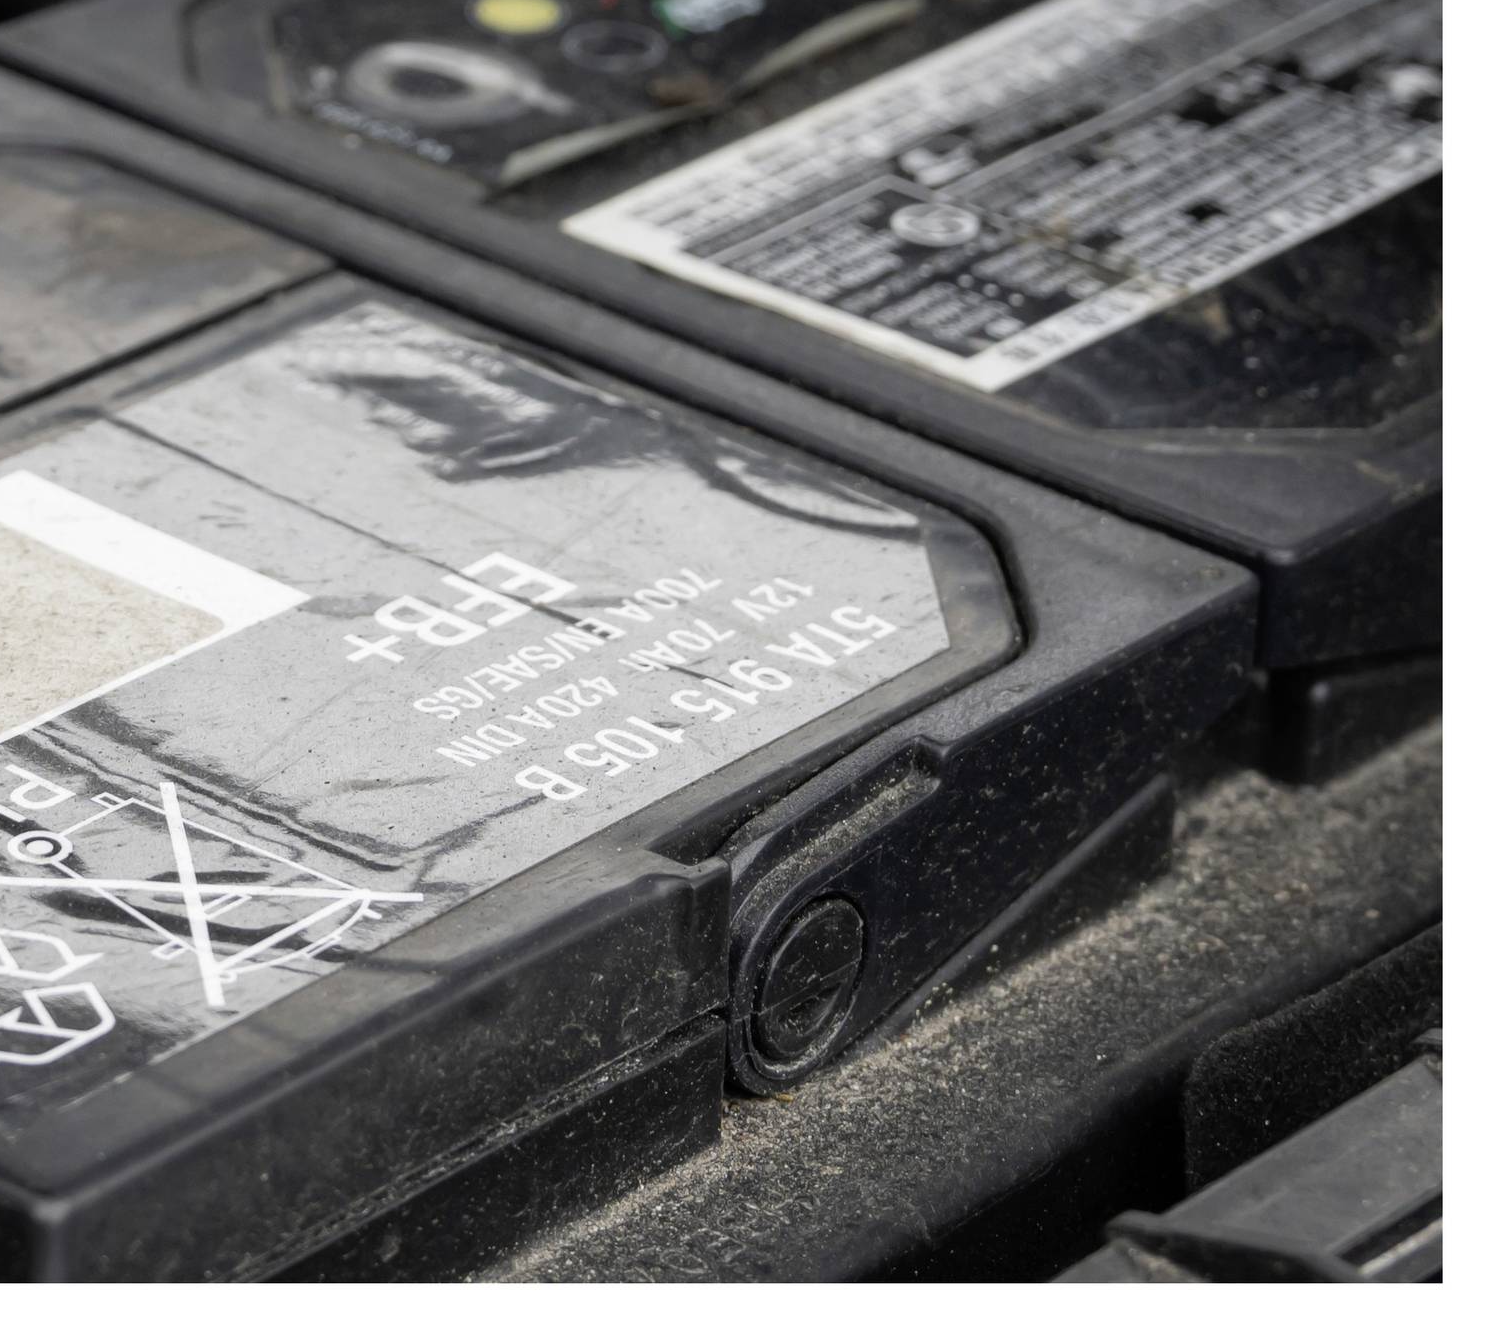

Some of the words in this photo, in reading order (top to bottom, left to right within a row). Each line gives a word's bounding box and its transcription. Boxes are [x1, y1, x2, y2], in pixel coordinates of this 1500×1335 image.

[343, 551, 579, 663] EFB+
[605, 568, 724, 623] 700A
[732, 577, 814, 622] 12V
[619, 618, 736, 671] 70Ah
[765, 606, 897, 666] 5TA
[413, 617, 626, 720] EN/SAE/GS
[670, 659, 793, 722] 915
[507, 675, 618, 729] 420A
[435, 723, 526, 767] DIN
[563, 716, 685, 777] 105
[515, 766, 588, 800] B
